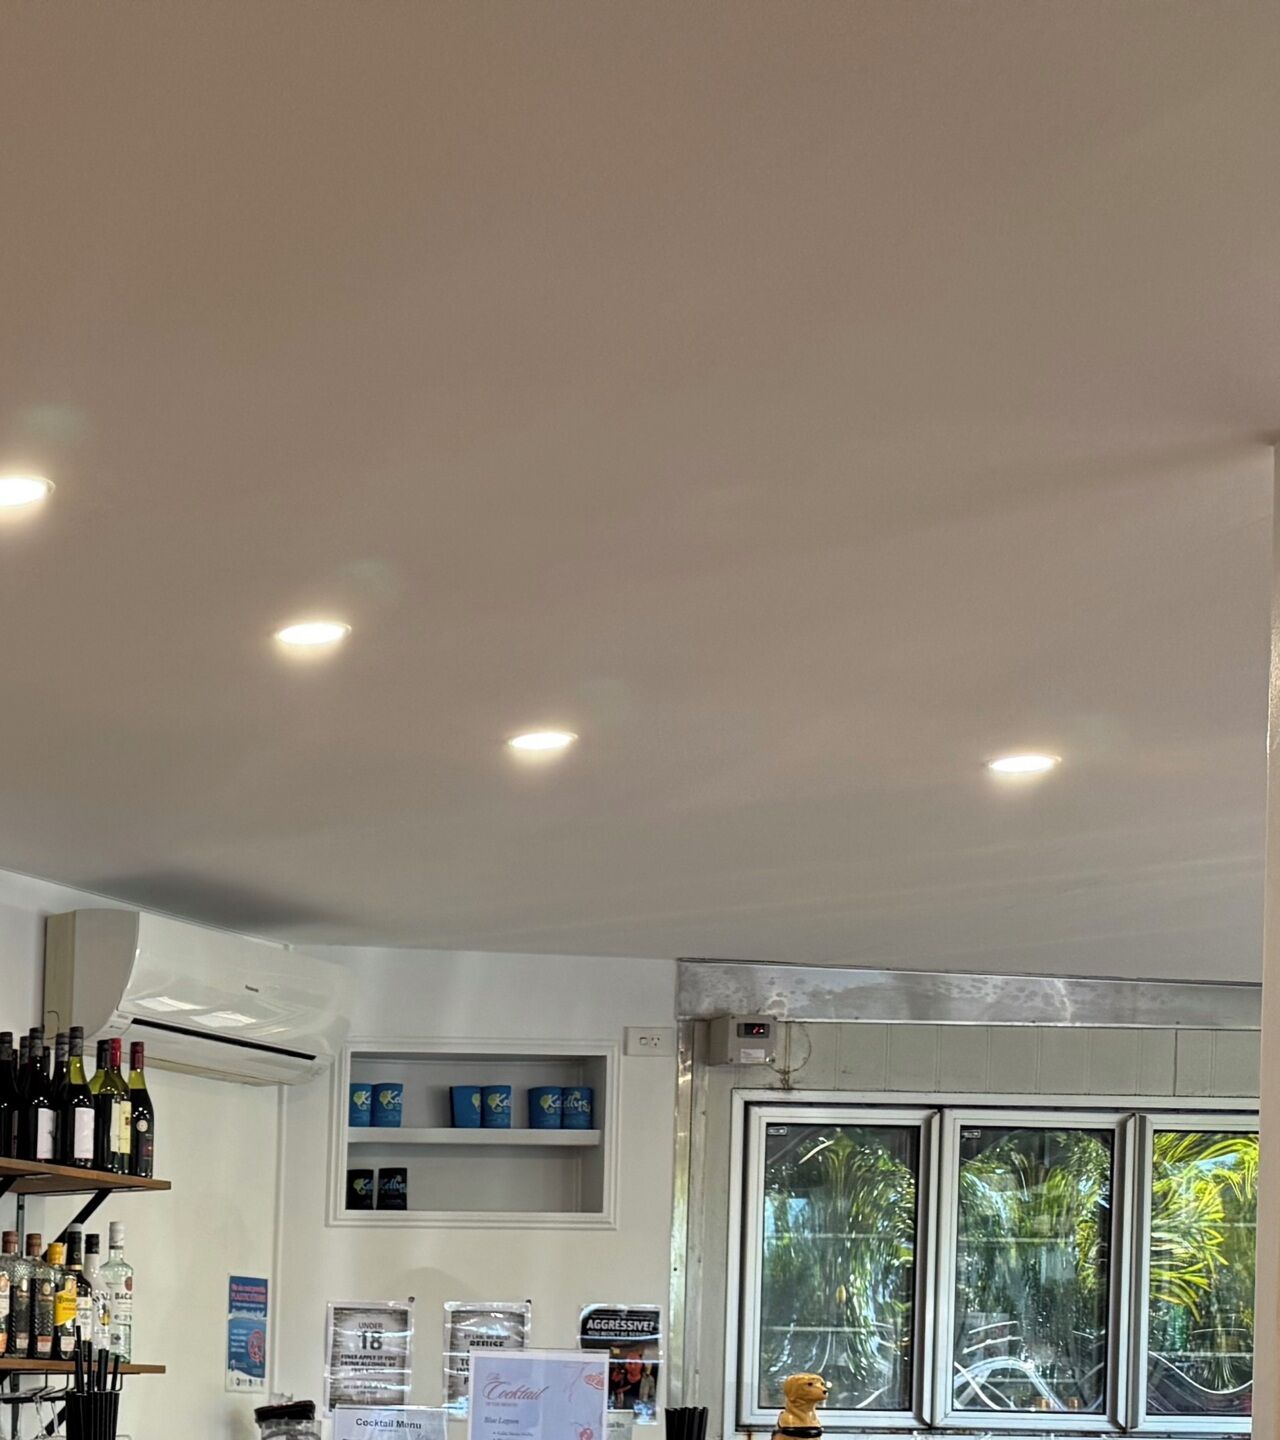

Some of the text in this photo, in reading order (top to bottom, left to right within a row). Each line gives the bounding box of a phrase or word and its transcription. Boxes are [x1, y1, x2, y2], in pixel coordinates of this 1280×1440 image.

[586, 1319, 655, 1331] AGGRESSIVE?
[358, 1330, 382, 1350] 18
[482, 1380, 549, 1400] Cocktail
[355, 1418, 422, 1430] Cocktail Menu
